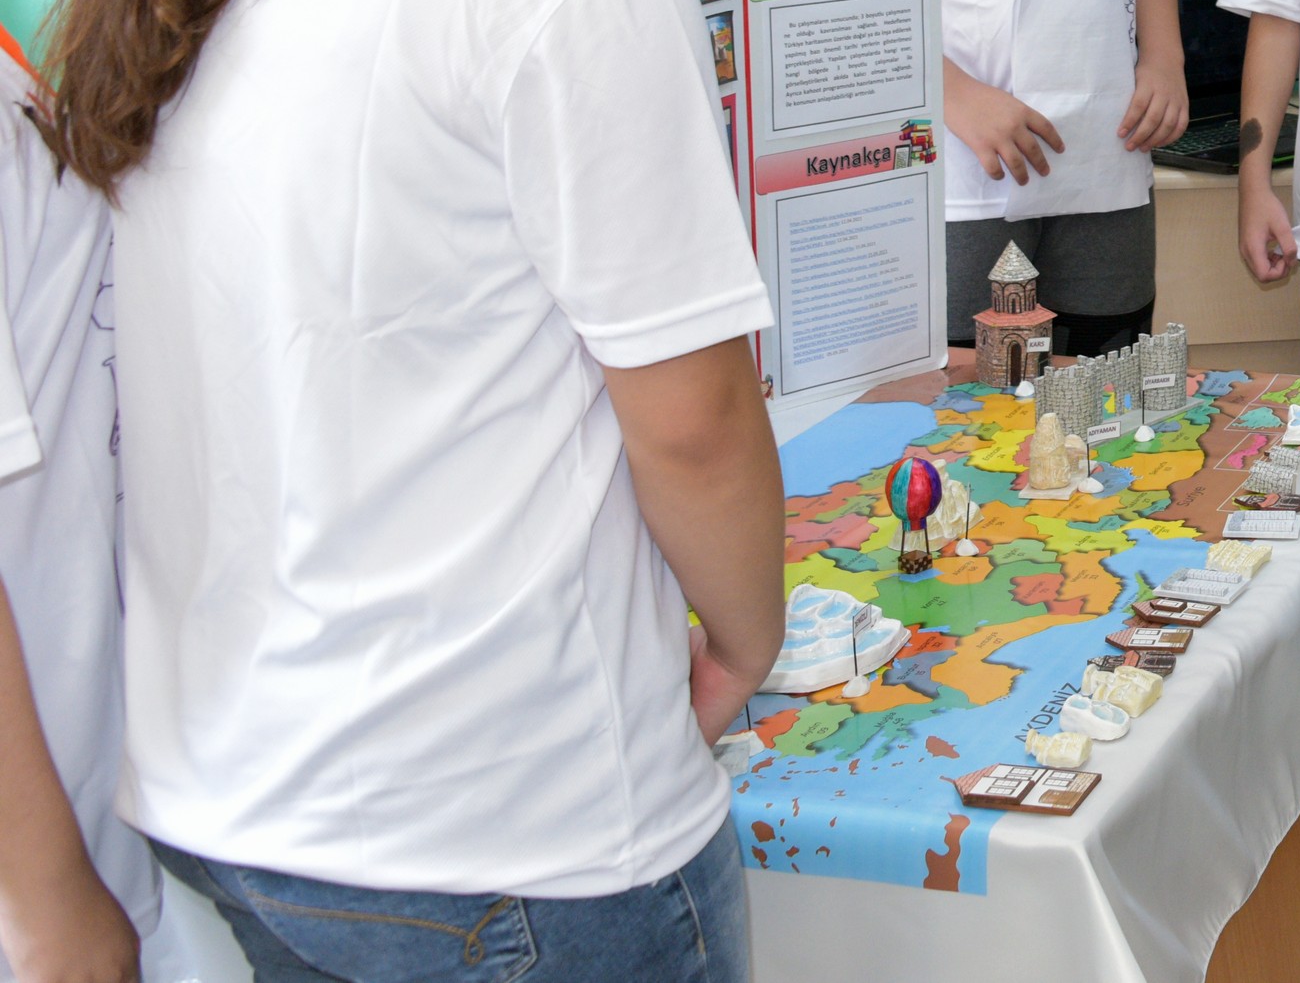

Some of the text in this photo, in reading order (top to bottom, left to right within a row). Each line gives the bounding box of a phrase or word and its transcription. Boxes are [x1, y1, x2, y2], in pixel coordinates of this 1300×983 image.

[806, 146, 892, 177] Kaynakça
[1029, 340, 1046, 348] KARS
[1177, 484, 1206, 508] Suriye
[921, 596, 940, 609] Konya
[800, 722, 822, 738] Aydın
